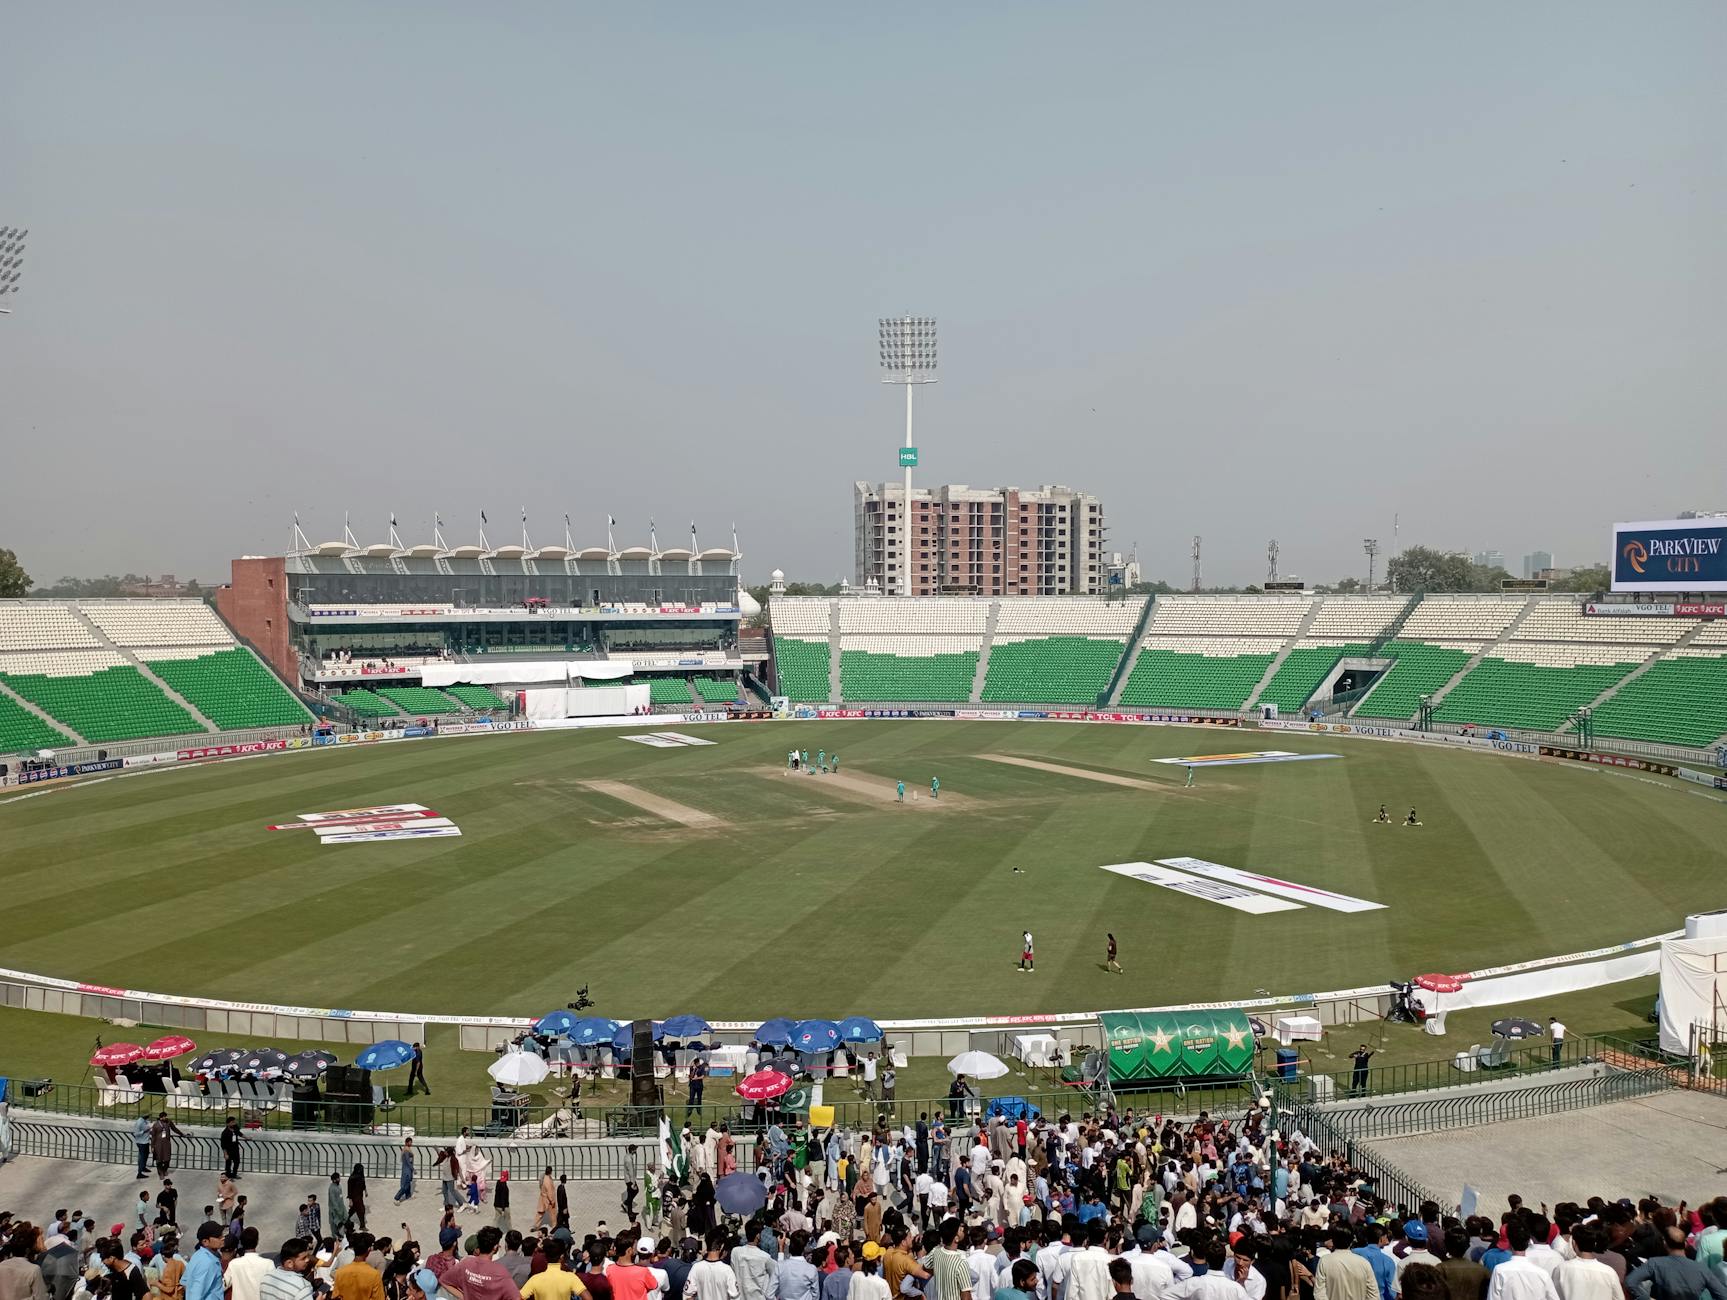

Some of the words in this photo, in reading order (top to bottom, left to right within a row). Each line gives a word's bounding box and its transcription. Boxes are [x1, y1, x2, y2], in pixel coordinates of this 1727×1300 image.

[1649, 538, 1723, 556] PARKVIEW
[1667, 557, 1700, 572] CITY
[683, 713, 703, 721] VGO
[705, 713, 720, 721] TEL
[491, 721, 511, 731] VGO
[1355, 726, 1375, 735] VGO
[1377, 728, 1393, 737] TEL
[241, 744, 259, 753] KFC
[266, 741, 283, 750] KFC
[1492, 740, 1512, 751] VGO
[1514, 744, 1534, 753] TEL
[162, 1045, 177, 1053] KFC
[766, 1083, 780, 1092] KFC
